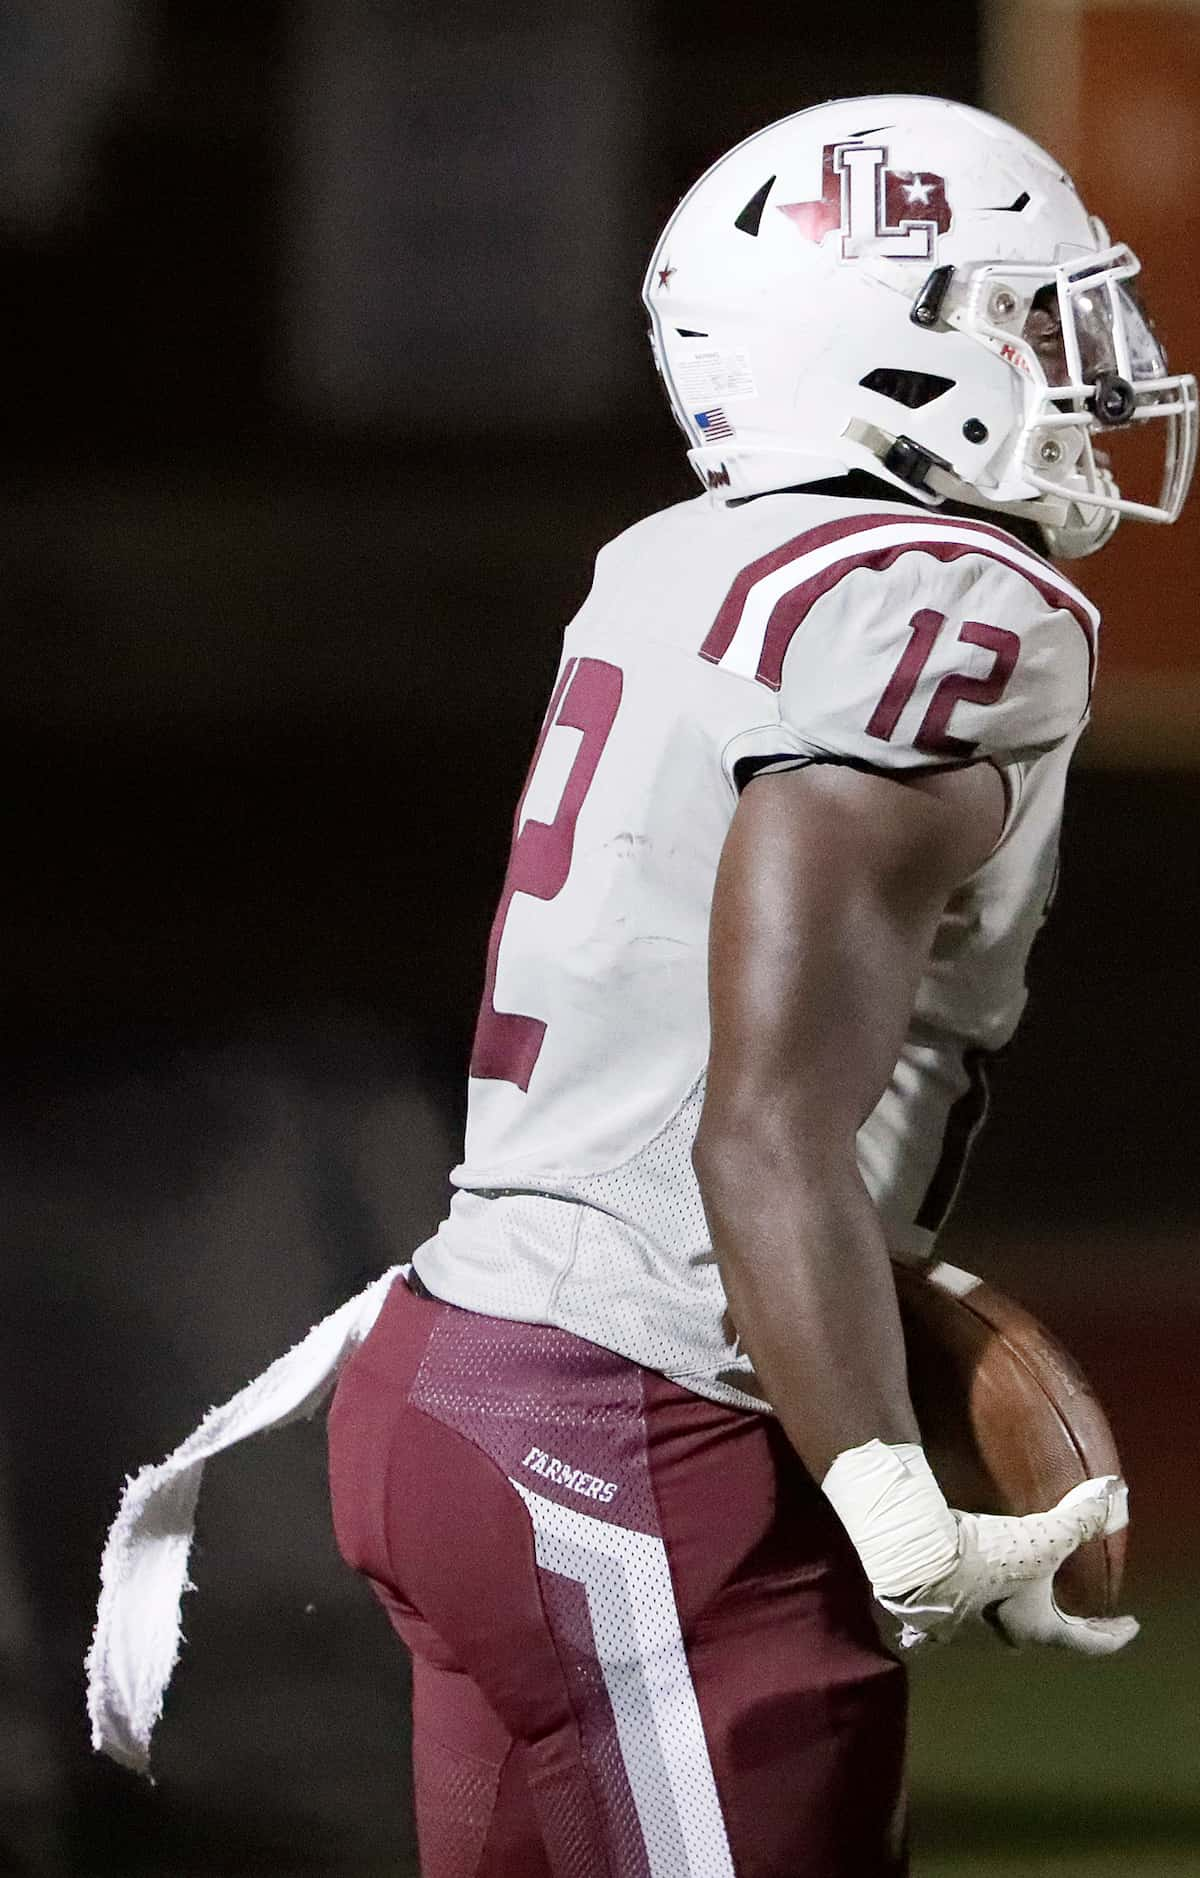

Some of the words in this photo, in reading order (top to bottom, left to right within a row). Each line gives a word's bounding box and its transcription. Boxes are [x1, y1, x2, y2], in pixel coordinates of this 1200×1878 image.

[864, 607, 1020, 756] 12
[470, 656, 623, 1094] 2
[521, 1446, 618, 1503] FARMERS
